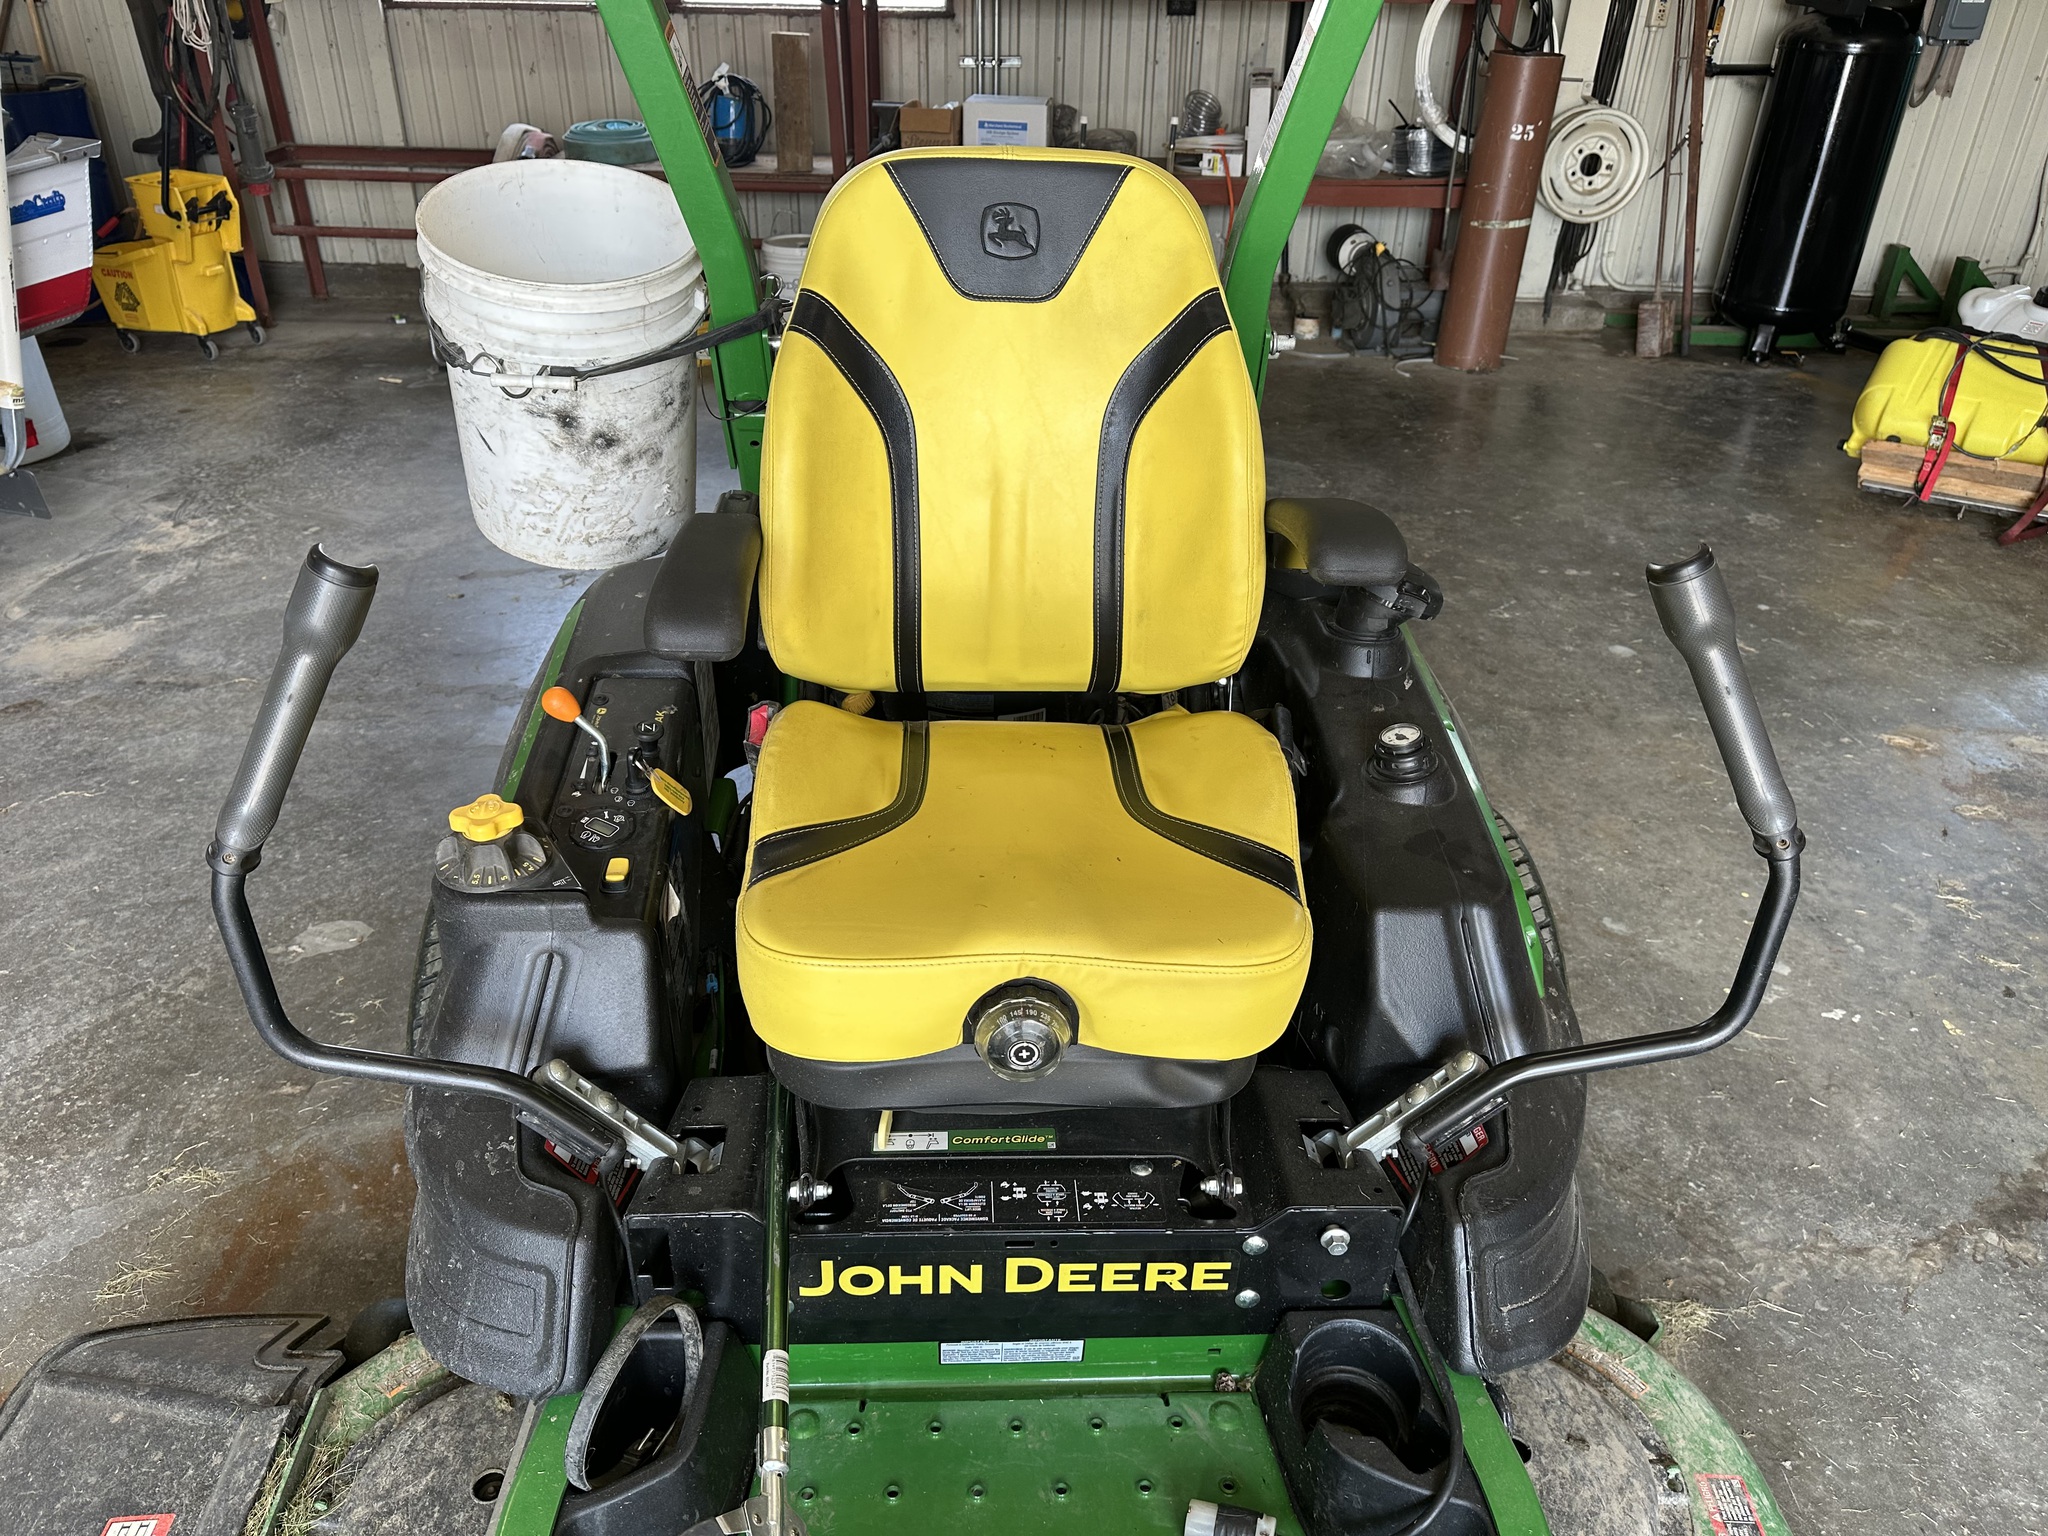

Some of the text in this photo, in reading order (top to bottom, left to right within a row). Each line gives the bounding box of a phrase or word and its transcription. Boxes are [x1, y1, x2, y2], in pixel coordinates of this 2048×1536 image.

[100, 267, 134, 280] CAUTION
[471, 873, 481, 885] 5.5
[1009, 1010, 1022, 1018] 145
[798, 1257, 1233, 1298] JOHN DEERE
